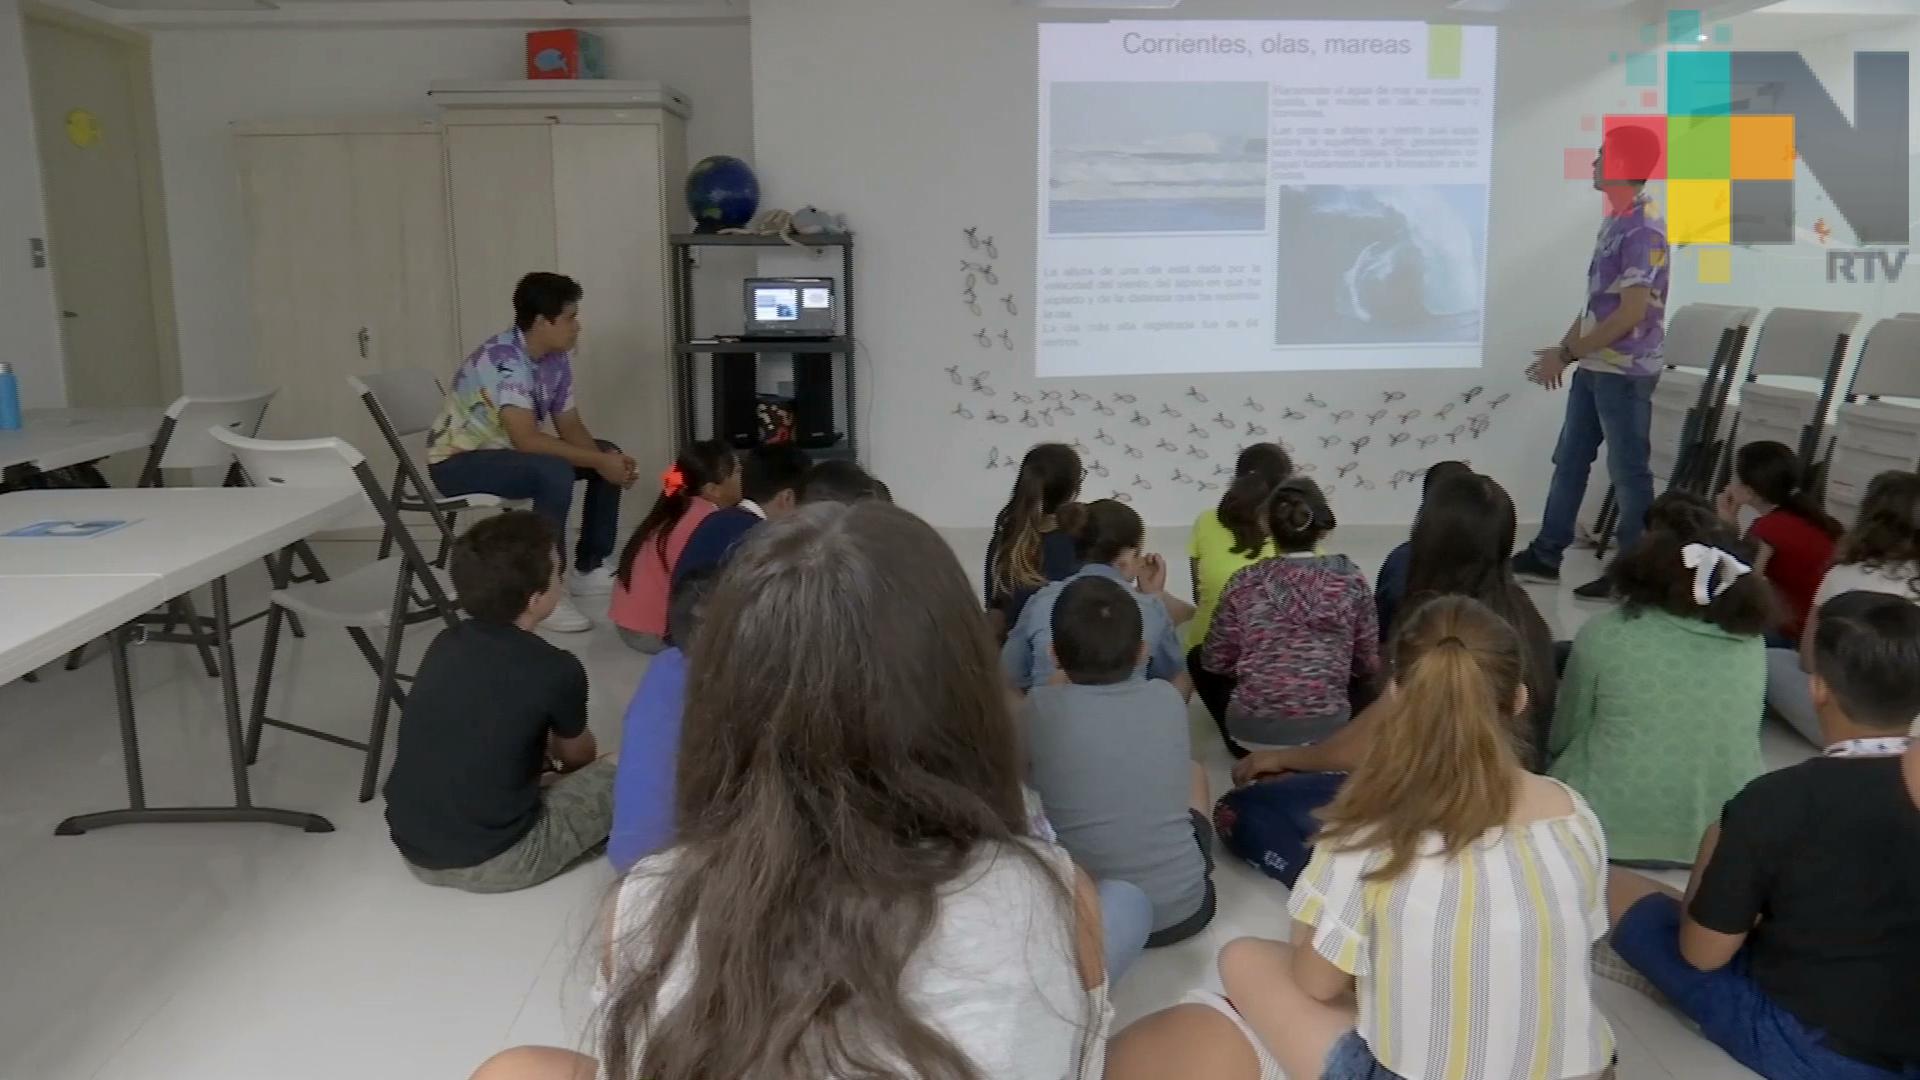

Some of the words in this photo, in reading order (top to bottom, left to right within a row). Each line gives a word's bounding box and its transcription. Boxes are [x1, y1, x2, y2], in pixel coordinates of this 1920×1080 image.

[1121, 31, 1253, 57] Corrientes,
[1260, 32, 1316, 57] olas,
[1323, 36, 1412, 55] mareas
